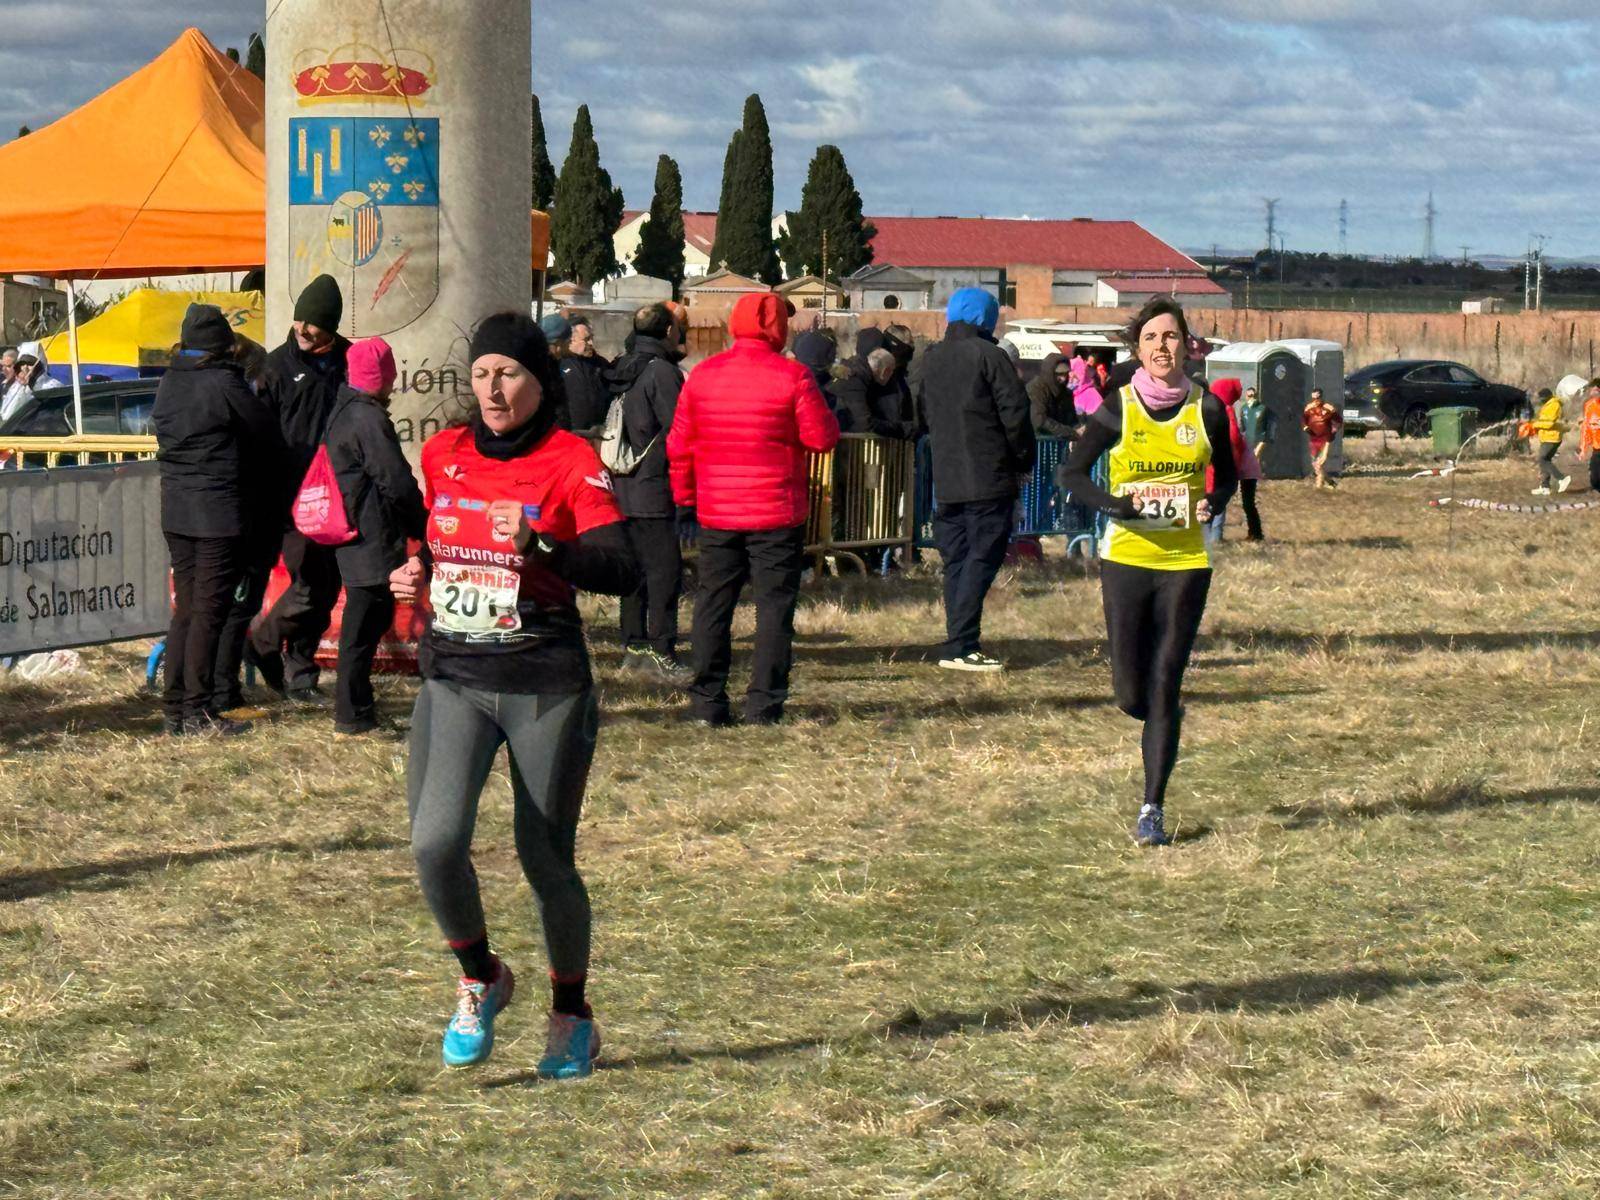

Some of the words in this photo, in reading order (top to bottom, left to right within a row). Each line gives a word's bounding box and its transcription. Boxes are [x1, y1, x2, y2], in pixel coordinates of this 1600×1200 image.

[395, 358, 457, 394] ión
[397, 417, 455, 442] an
[1143, 499, 1177, 520] 36
[0, 524, 113, 573] Diputación
[0, 597, 19, 623] de
[26, 581, 136, 621] Salamanca
